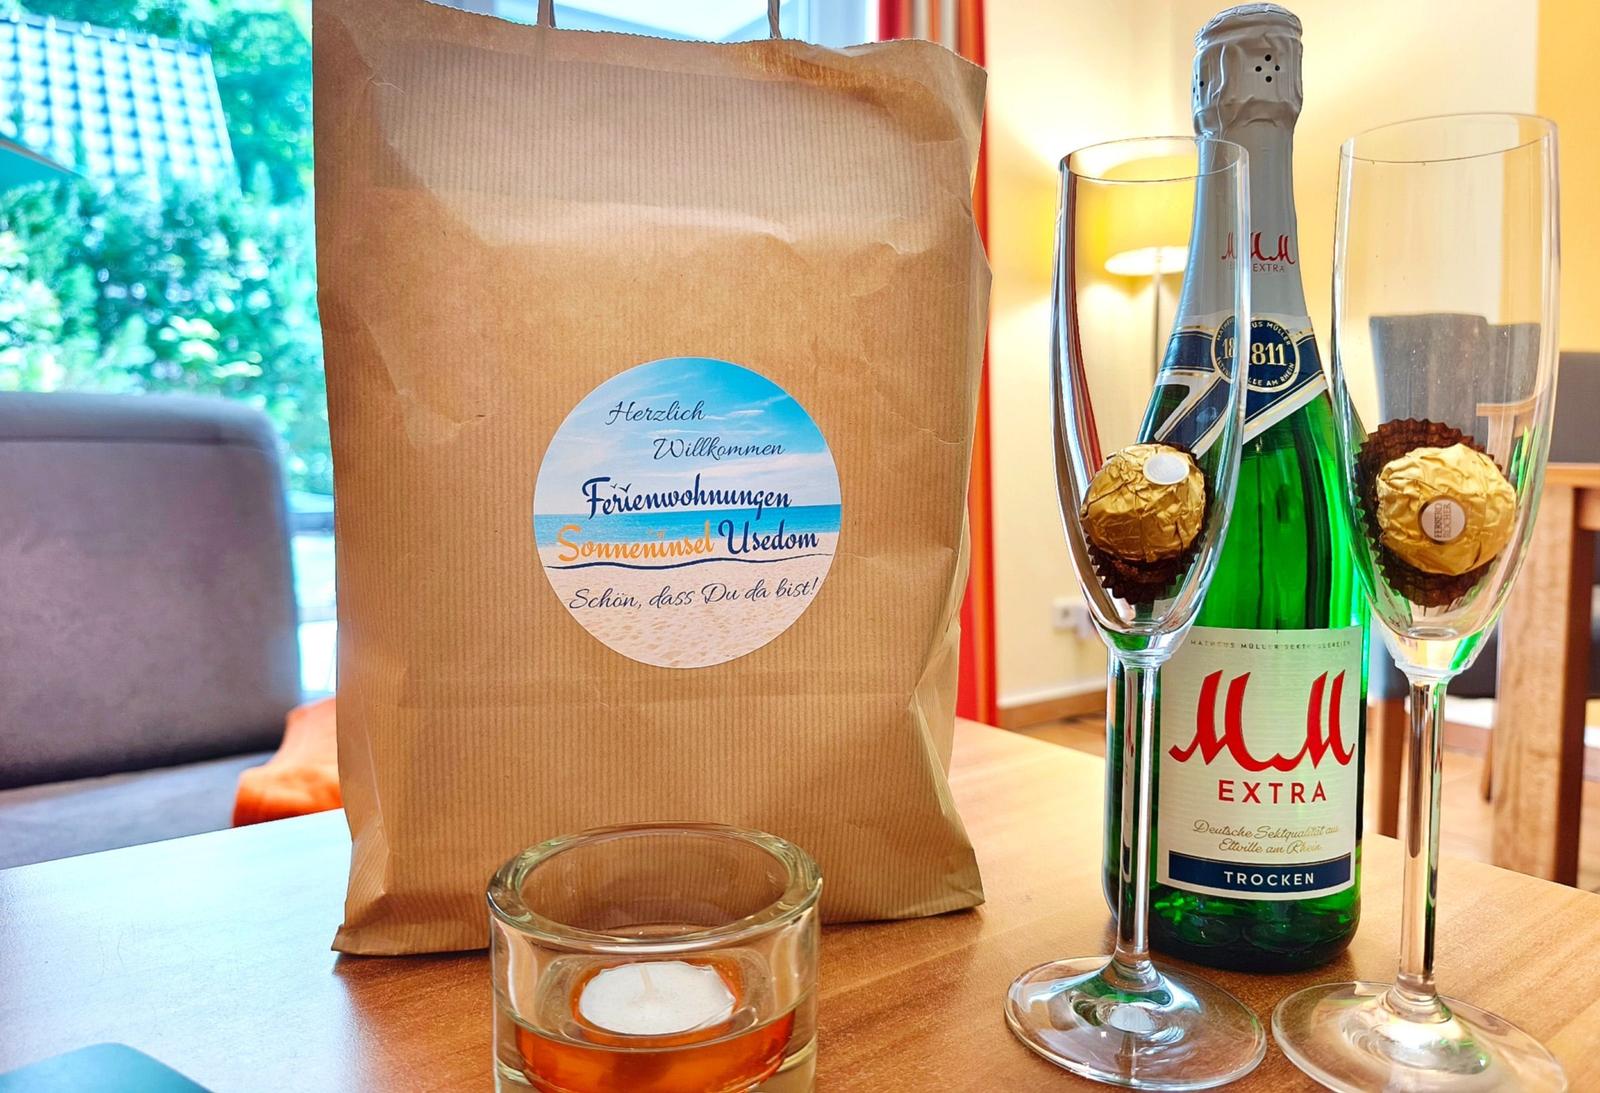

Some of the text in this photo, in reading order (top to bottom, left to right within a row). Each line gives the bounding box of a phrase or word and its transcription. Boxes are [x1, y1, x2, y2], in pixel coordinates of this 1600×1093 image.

[605, 400, 705, 426] Herzlich
[652, 436, 786, 461] Willkommen
[581, 473, 793, 521] Ferienwohnungen
[555, 519, 820, 563] Sonneninsel Usedom
[568, 576, 820, 610] Schön, dass Du da bist!
[1168, 669, 1356, 772] MM
[1218, 779, 1328, 804] EXTRA
[1192, 819, 1254, 839] Deutsche
[1218, 837, 1263, 854] Eltville
[1223, 870, 1315, 887] TROCKEN
